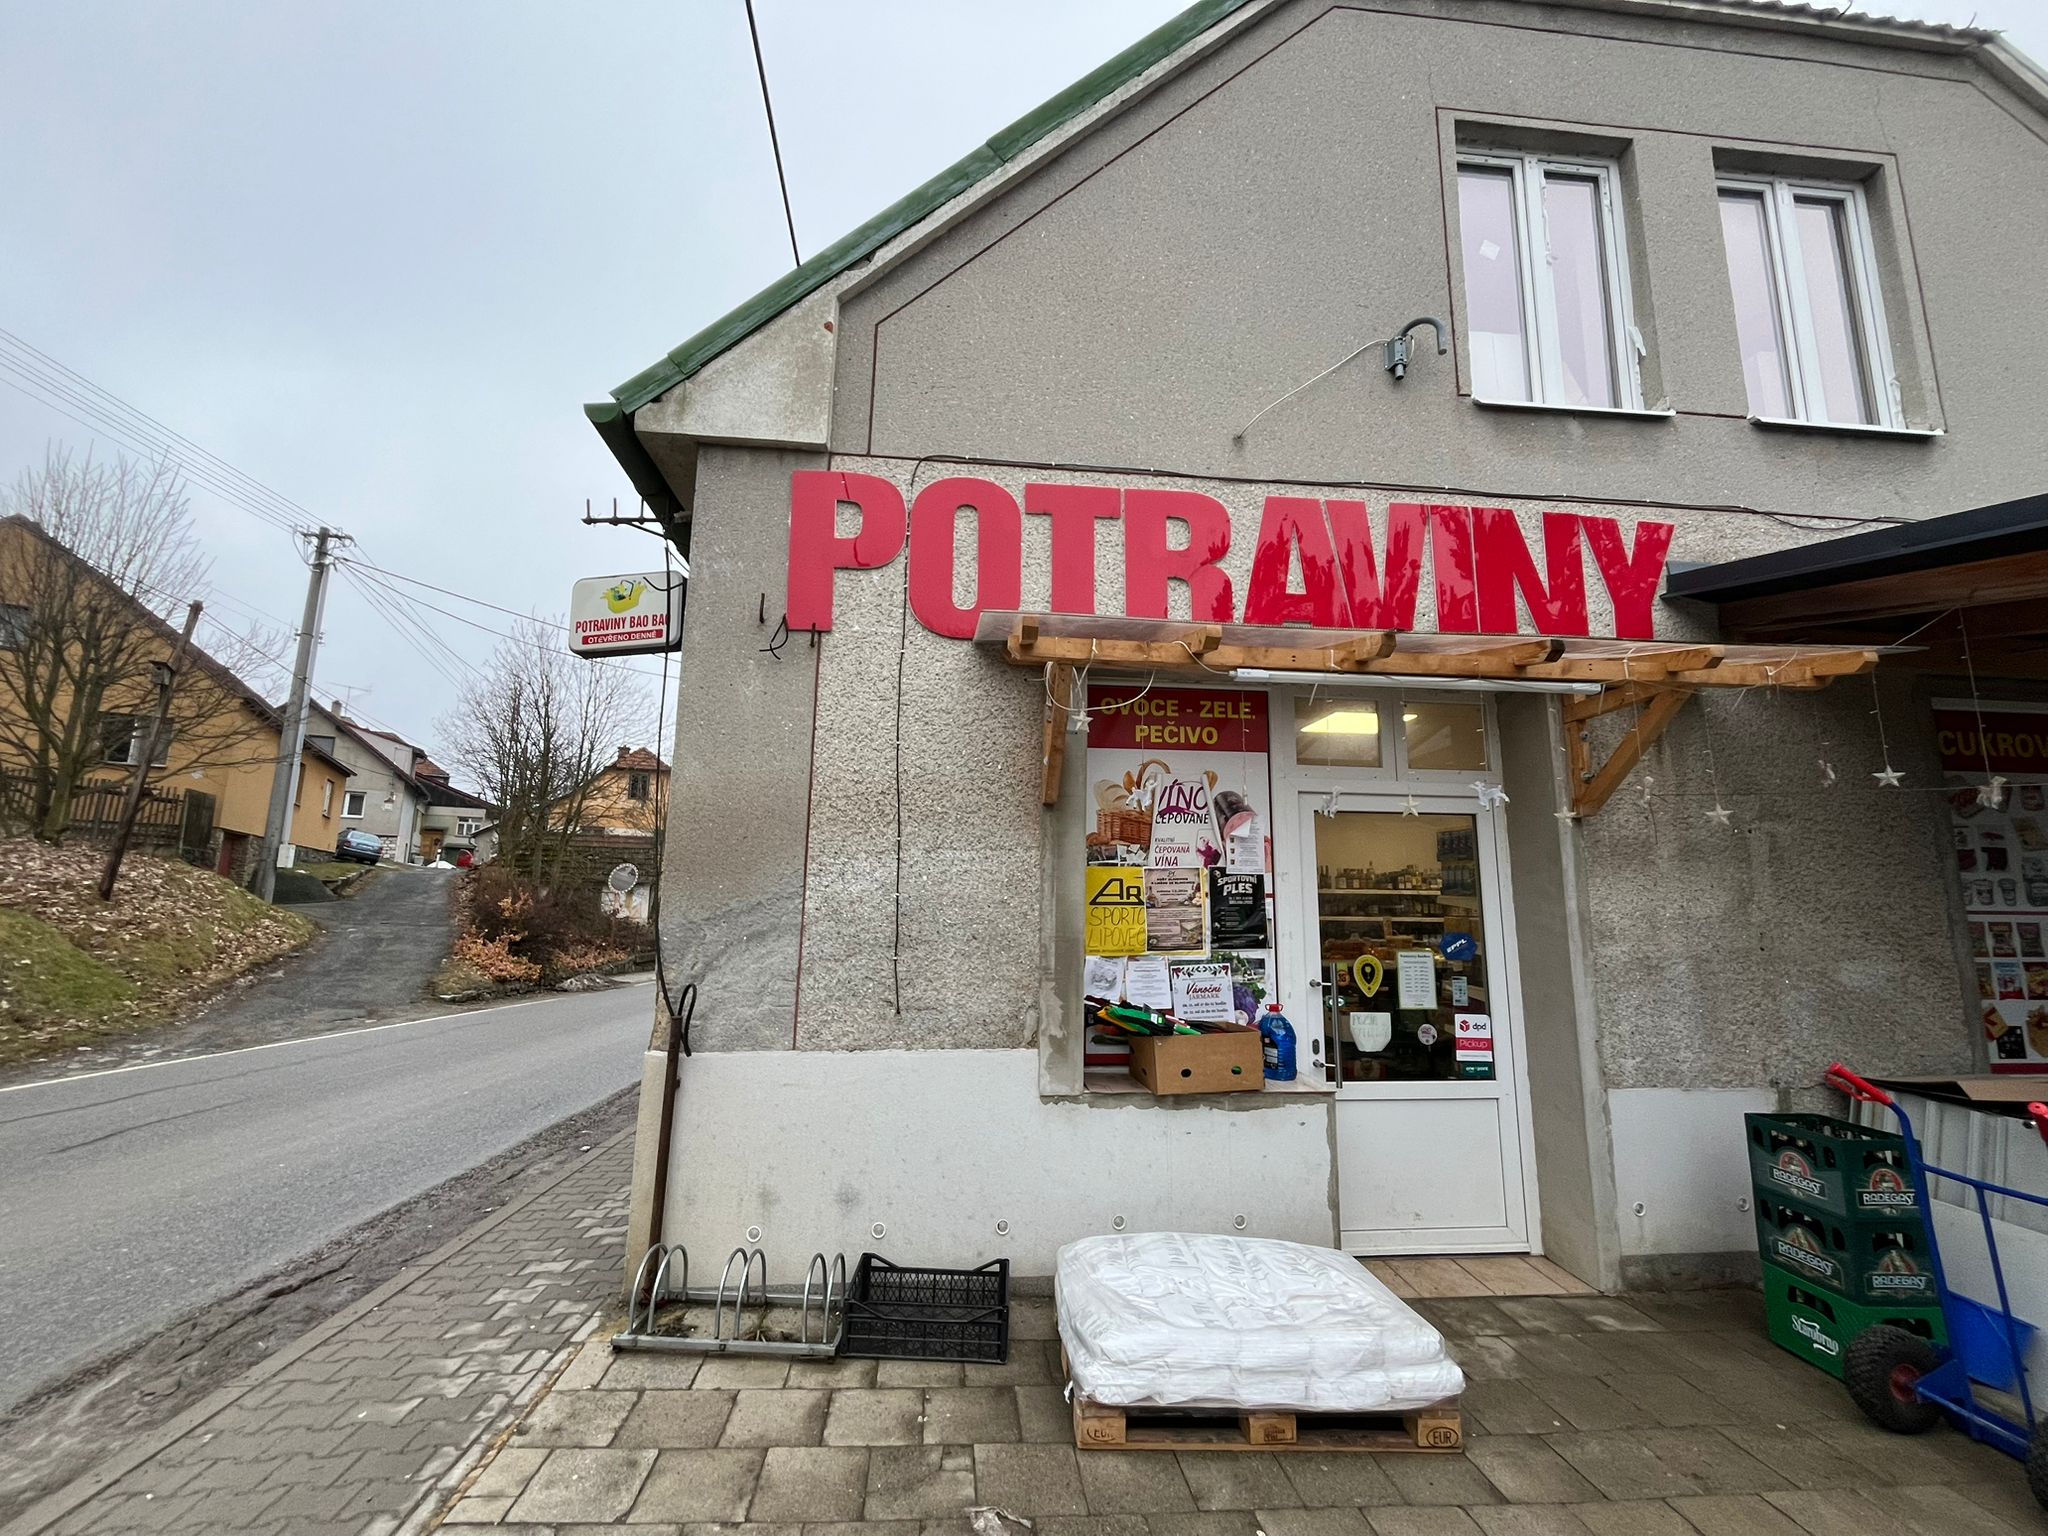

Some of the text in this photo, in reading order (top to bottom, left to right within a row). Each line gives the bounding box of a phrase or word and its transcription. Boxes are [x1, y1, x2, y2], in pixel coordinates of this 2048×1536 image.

[787, 470, 1675, 640] POTRAVINY
[575, 617, 627, 634] POTRAVINY
[630, 614, 648, 629] BAO
[1100, 697, 1180, 718] OVOCE
[1199, 700, 1256, 720] ZELE.
[1135, 720, 1219, 745] PEČIVO
[1154, 853, 1179, 867] VÍNA
[1222, 882, 1253, 897] PLES
[1186, 982, 1222, 995] Vánoční
[1472, 1021, 1487, 1032] dpd
[1458, 1038, 1489, 1049] Pickup
[1773, 1168, 1822, 1195] RADEGAST
[1863, 1193, 1916, 1205] RADEGAST
[1778, 1241, 1834, 1274] RADEGAST
[1872, 1276, 1927, 1288] RADEGAST
[1791, 1314, 1840, 1355] Starobrno
[1432, 1430, 1452, 1444] EUR
